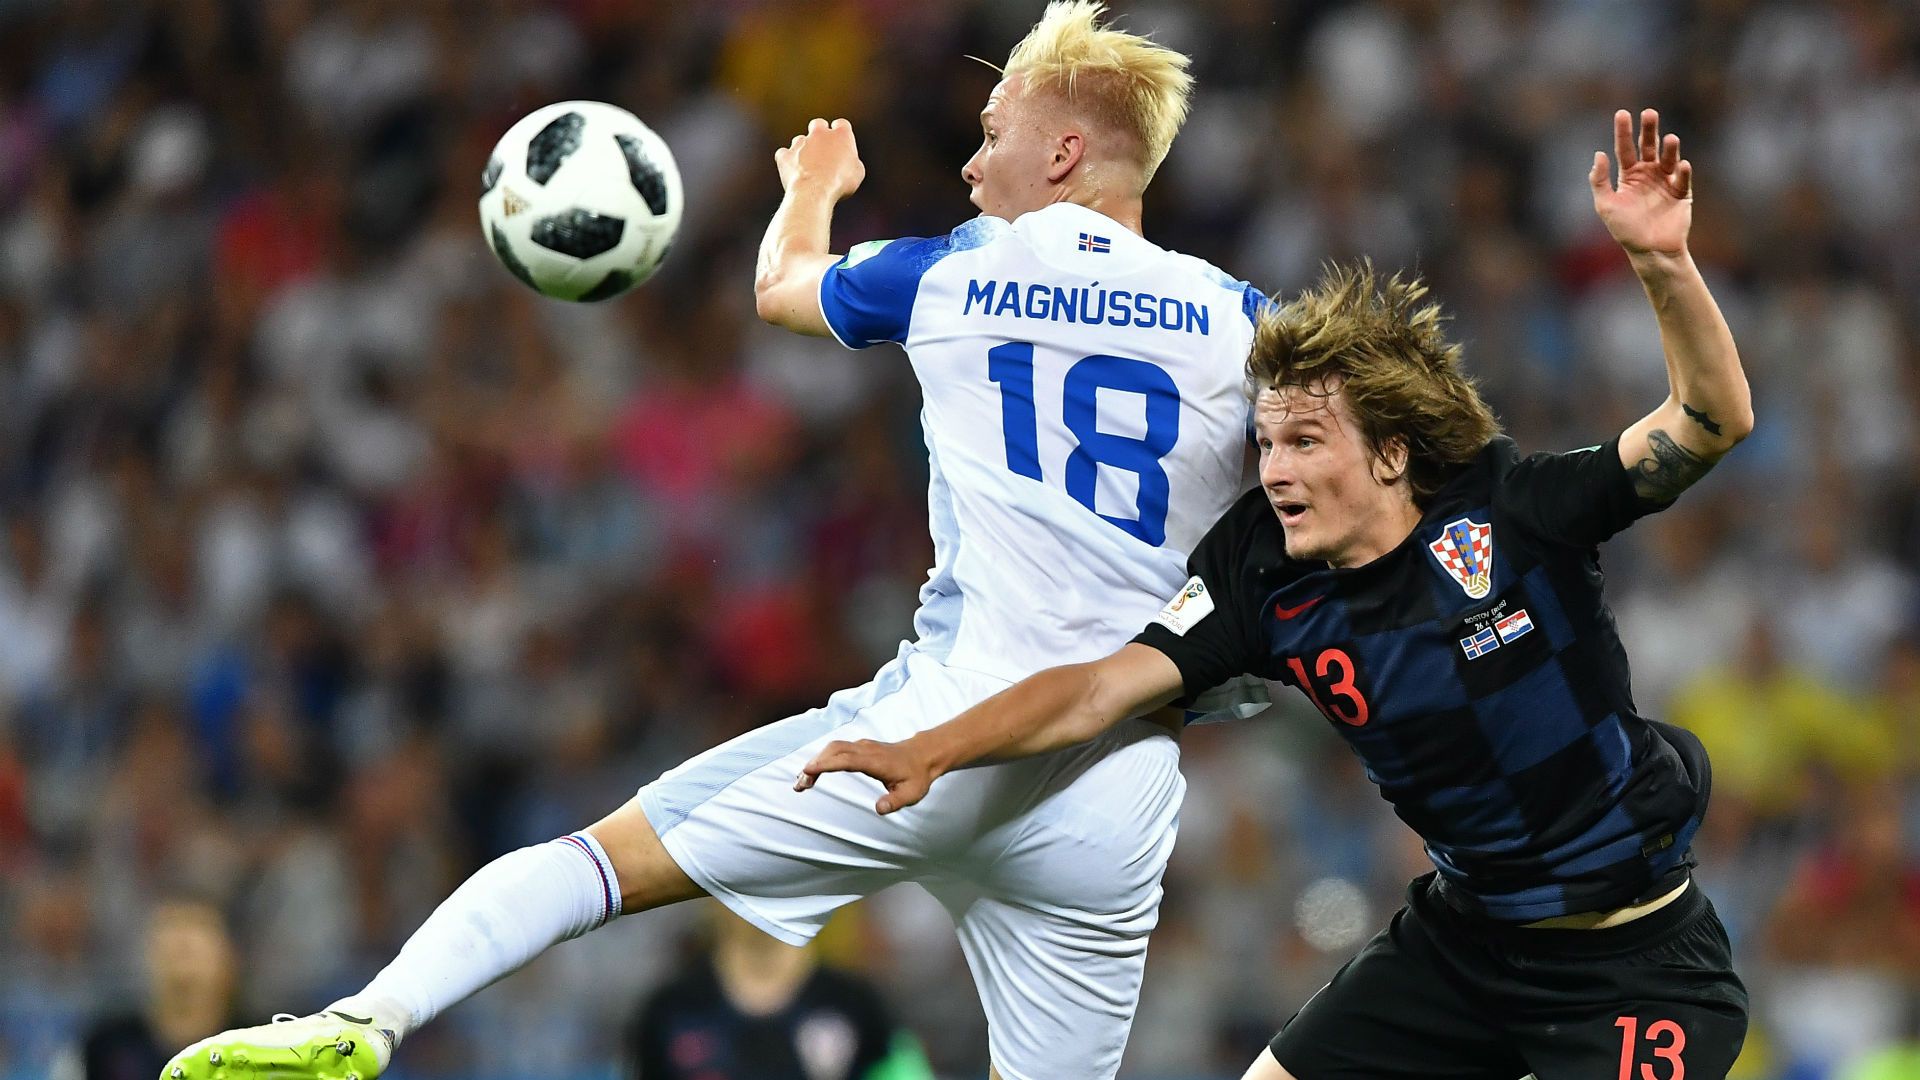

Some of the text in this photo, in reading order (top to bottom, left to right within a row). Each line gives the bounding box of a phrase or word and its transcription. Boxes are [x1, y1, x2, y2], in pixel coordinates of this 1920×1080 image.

[963, 279, 1210, 336] MAGNÚSSON
[988, 341, 1180, 548] 18
[1287, 648, 1369, 727] 13
[1614, 1016, 1686, 1080] 13
